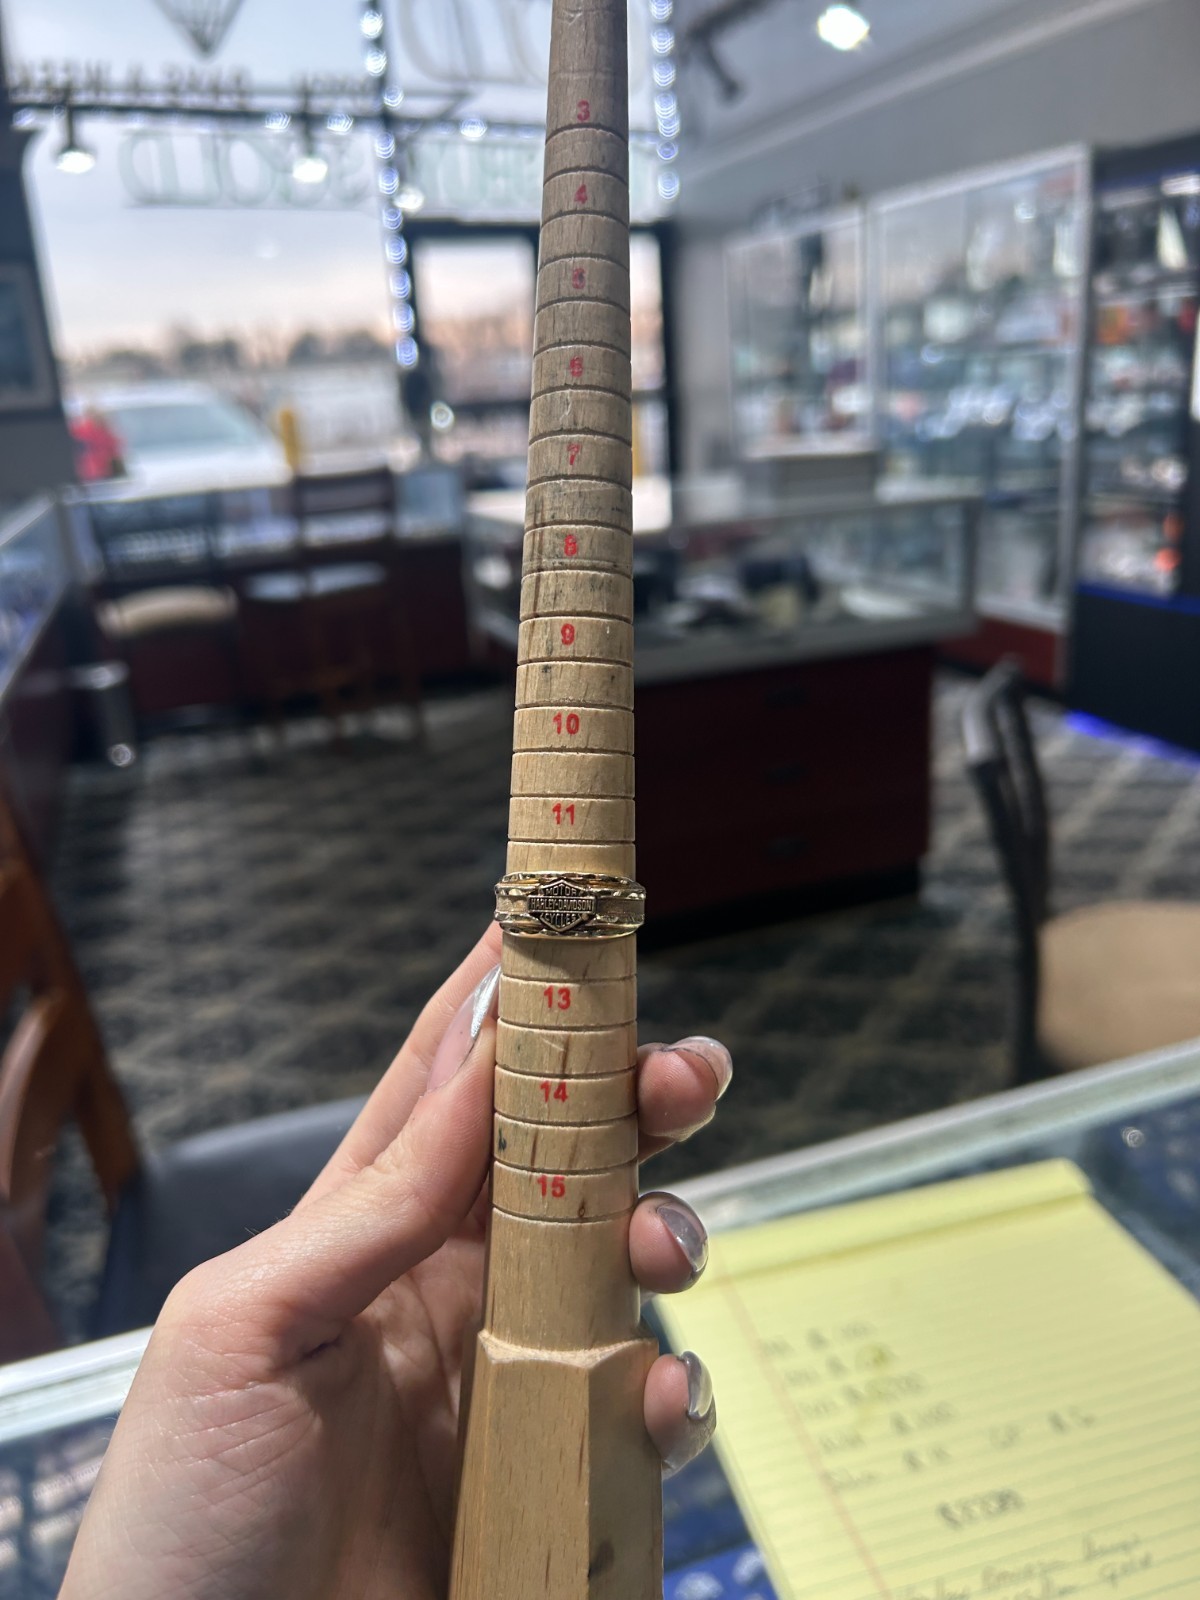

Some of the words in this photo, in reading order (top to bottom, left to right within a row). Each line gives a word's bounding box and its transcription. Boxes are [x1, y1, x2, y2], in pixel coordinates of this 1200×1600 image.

[576, 99, 591, 122] 3
[574, 183, 588, 204] 4
[569, 355, 584, 378] 6
[566, 442, 582, 466] 7
[563, 534, 578, 557] 8
[560, 623, 575, 646] 9
[552, 712, 580, 735] 10
[552, 802, 576, 825] 11
[546, 883, 577, 896] MOTOR
[531, 898, 592, 910] HARLEY-DAVIDSON
[545, 913, 576, 927] CYCLES
[543, 985, 572, 1011] 13
[539, 1080, 569, 1104] 14
[536, 1174, 567, 1199] 15
